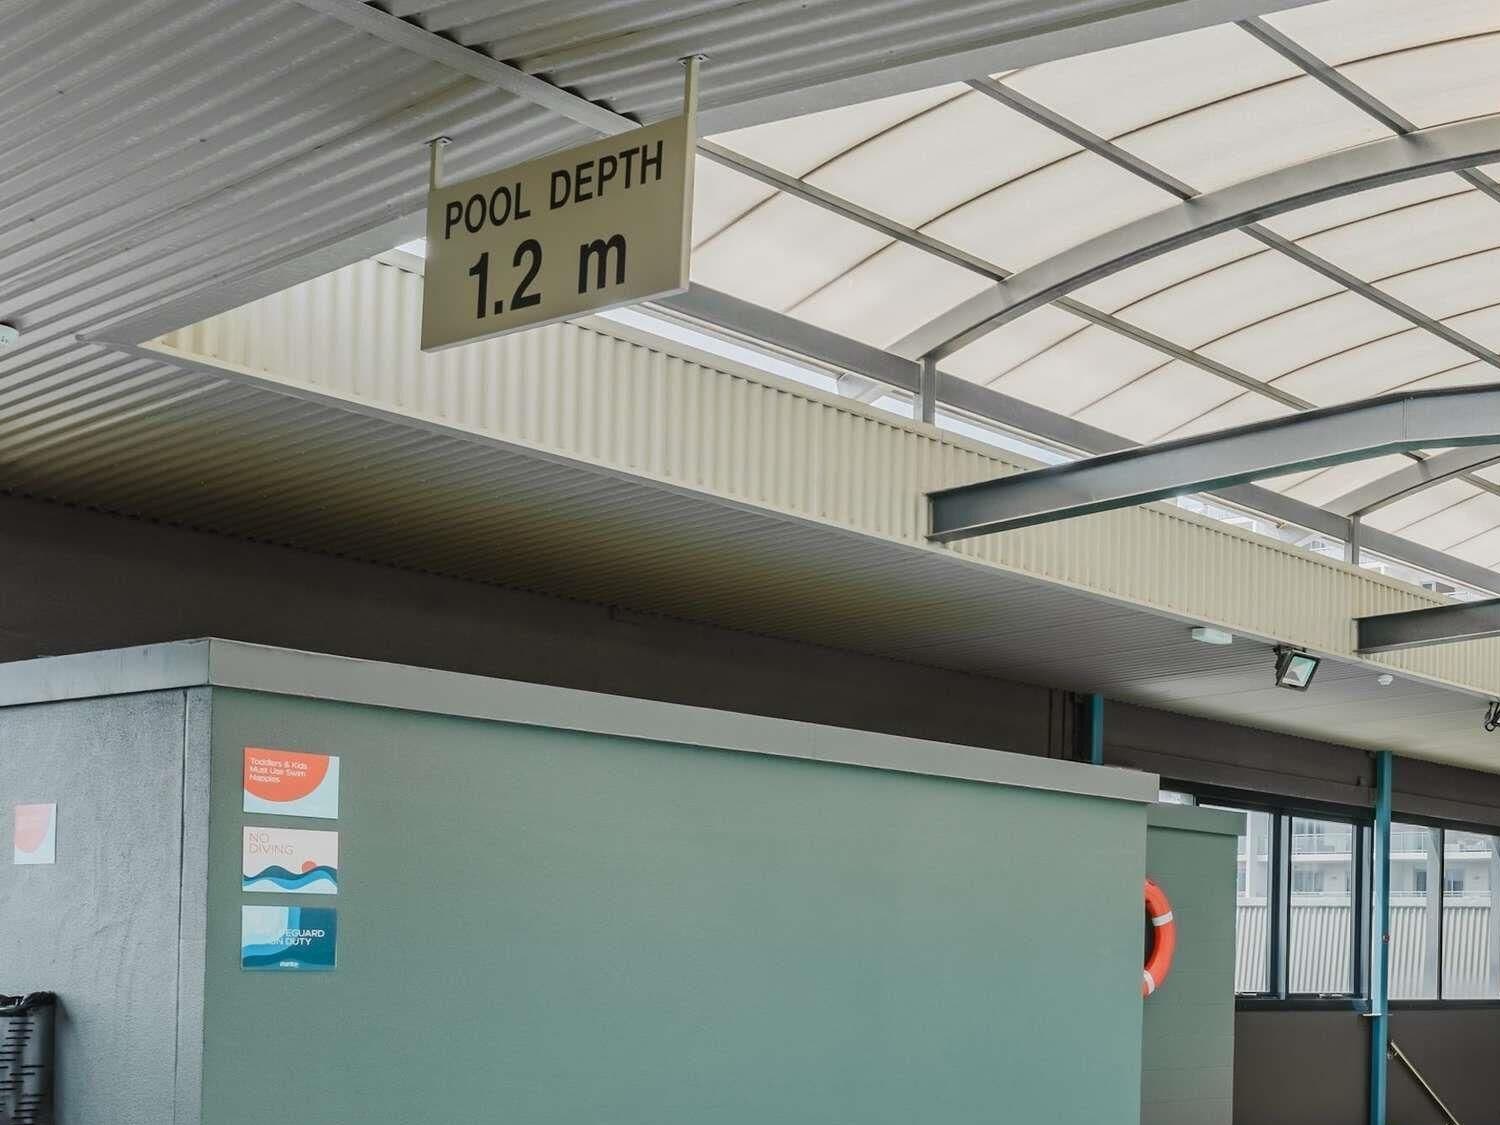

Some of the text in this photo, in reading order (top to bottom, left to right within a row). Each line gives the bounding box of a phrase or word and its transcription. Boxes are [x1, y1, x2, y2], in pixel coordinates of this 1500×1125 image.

[444, 140, 664, 239] POOL DEPTH
[468, 233, 627, 319] 1.2 m
[249, 757, 282, 767] Toddlers
[291, 760, 308, 770] Kids
[249, 766, 306, 777] Must Use Swim
[248, 832, 270, 843] NO
[248, 843, 294, 855] DIVING
[277, 928, 325, 938] FEGUARD
[286, 937, 312, 946] DUTY
